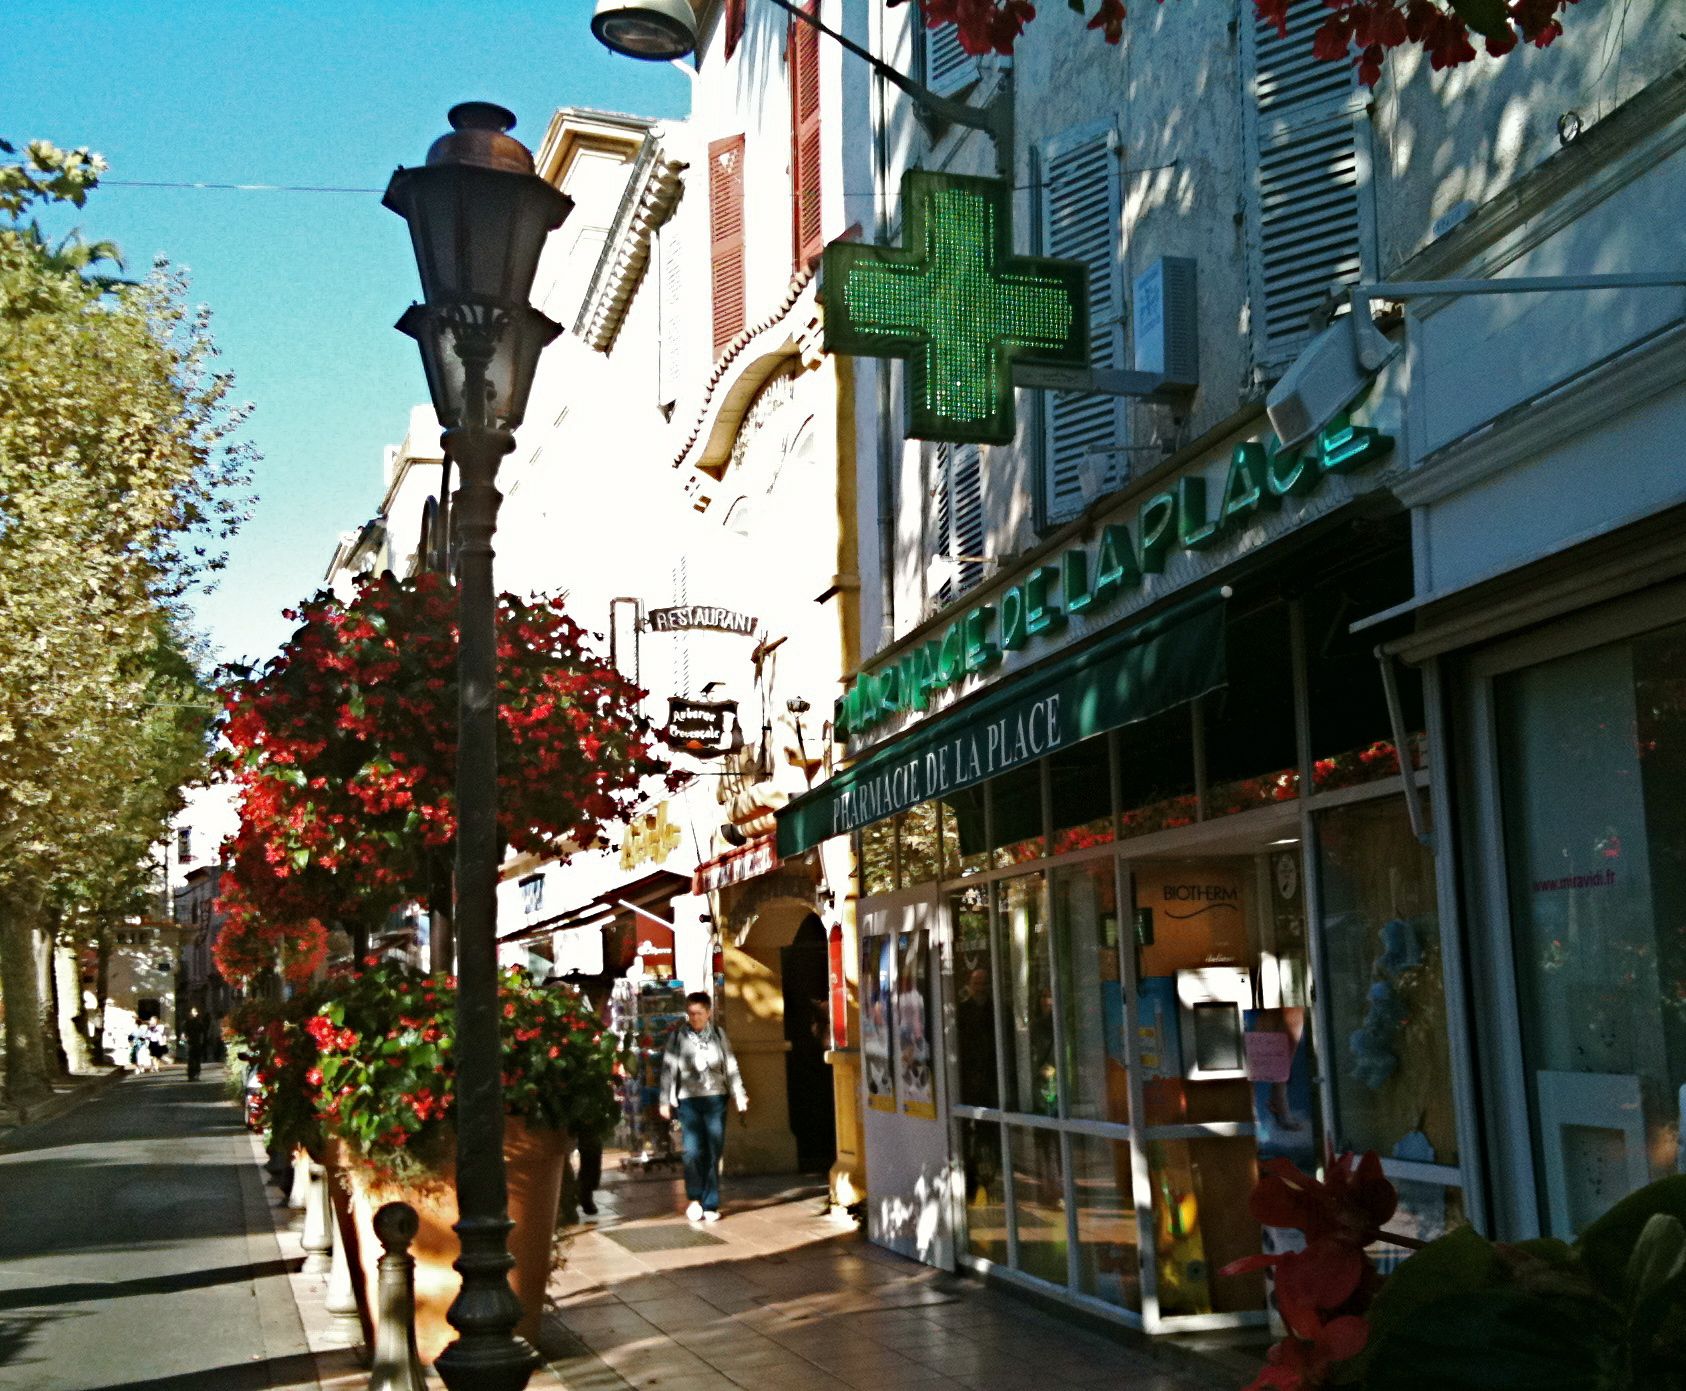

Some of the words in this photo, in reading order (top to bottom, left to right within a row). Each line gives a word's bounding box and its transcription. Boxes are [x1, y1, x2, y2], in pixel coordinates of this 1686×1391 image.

[656, 606, 753, 633] RESTAURANT
[834, 606, 1003, 741] PHARMACIE
[1001, 566, 1068, 650] DE
[1063, 523, 1141, 615] LA
[832, 766, 921, 834] PHARMACIE
[926, 750, 950, 798] DE
[954, 738, 982, 784] LA
[986, 693, 1062, 774] PLACE
[1164, 885, 1238, 901] BIOTHERM
